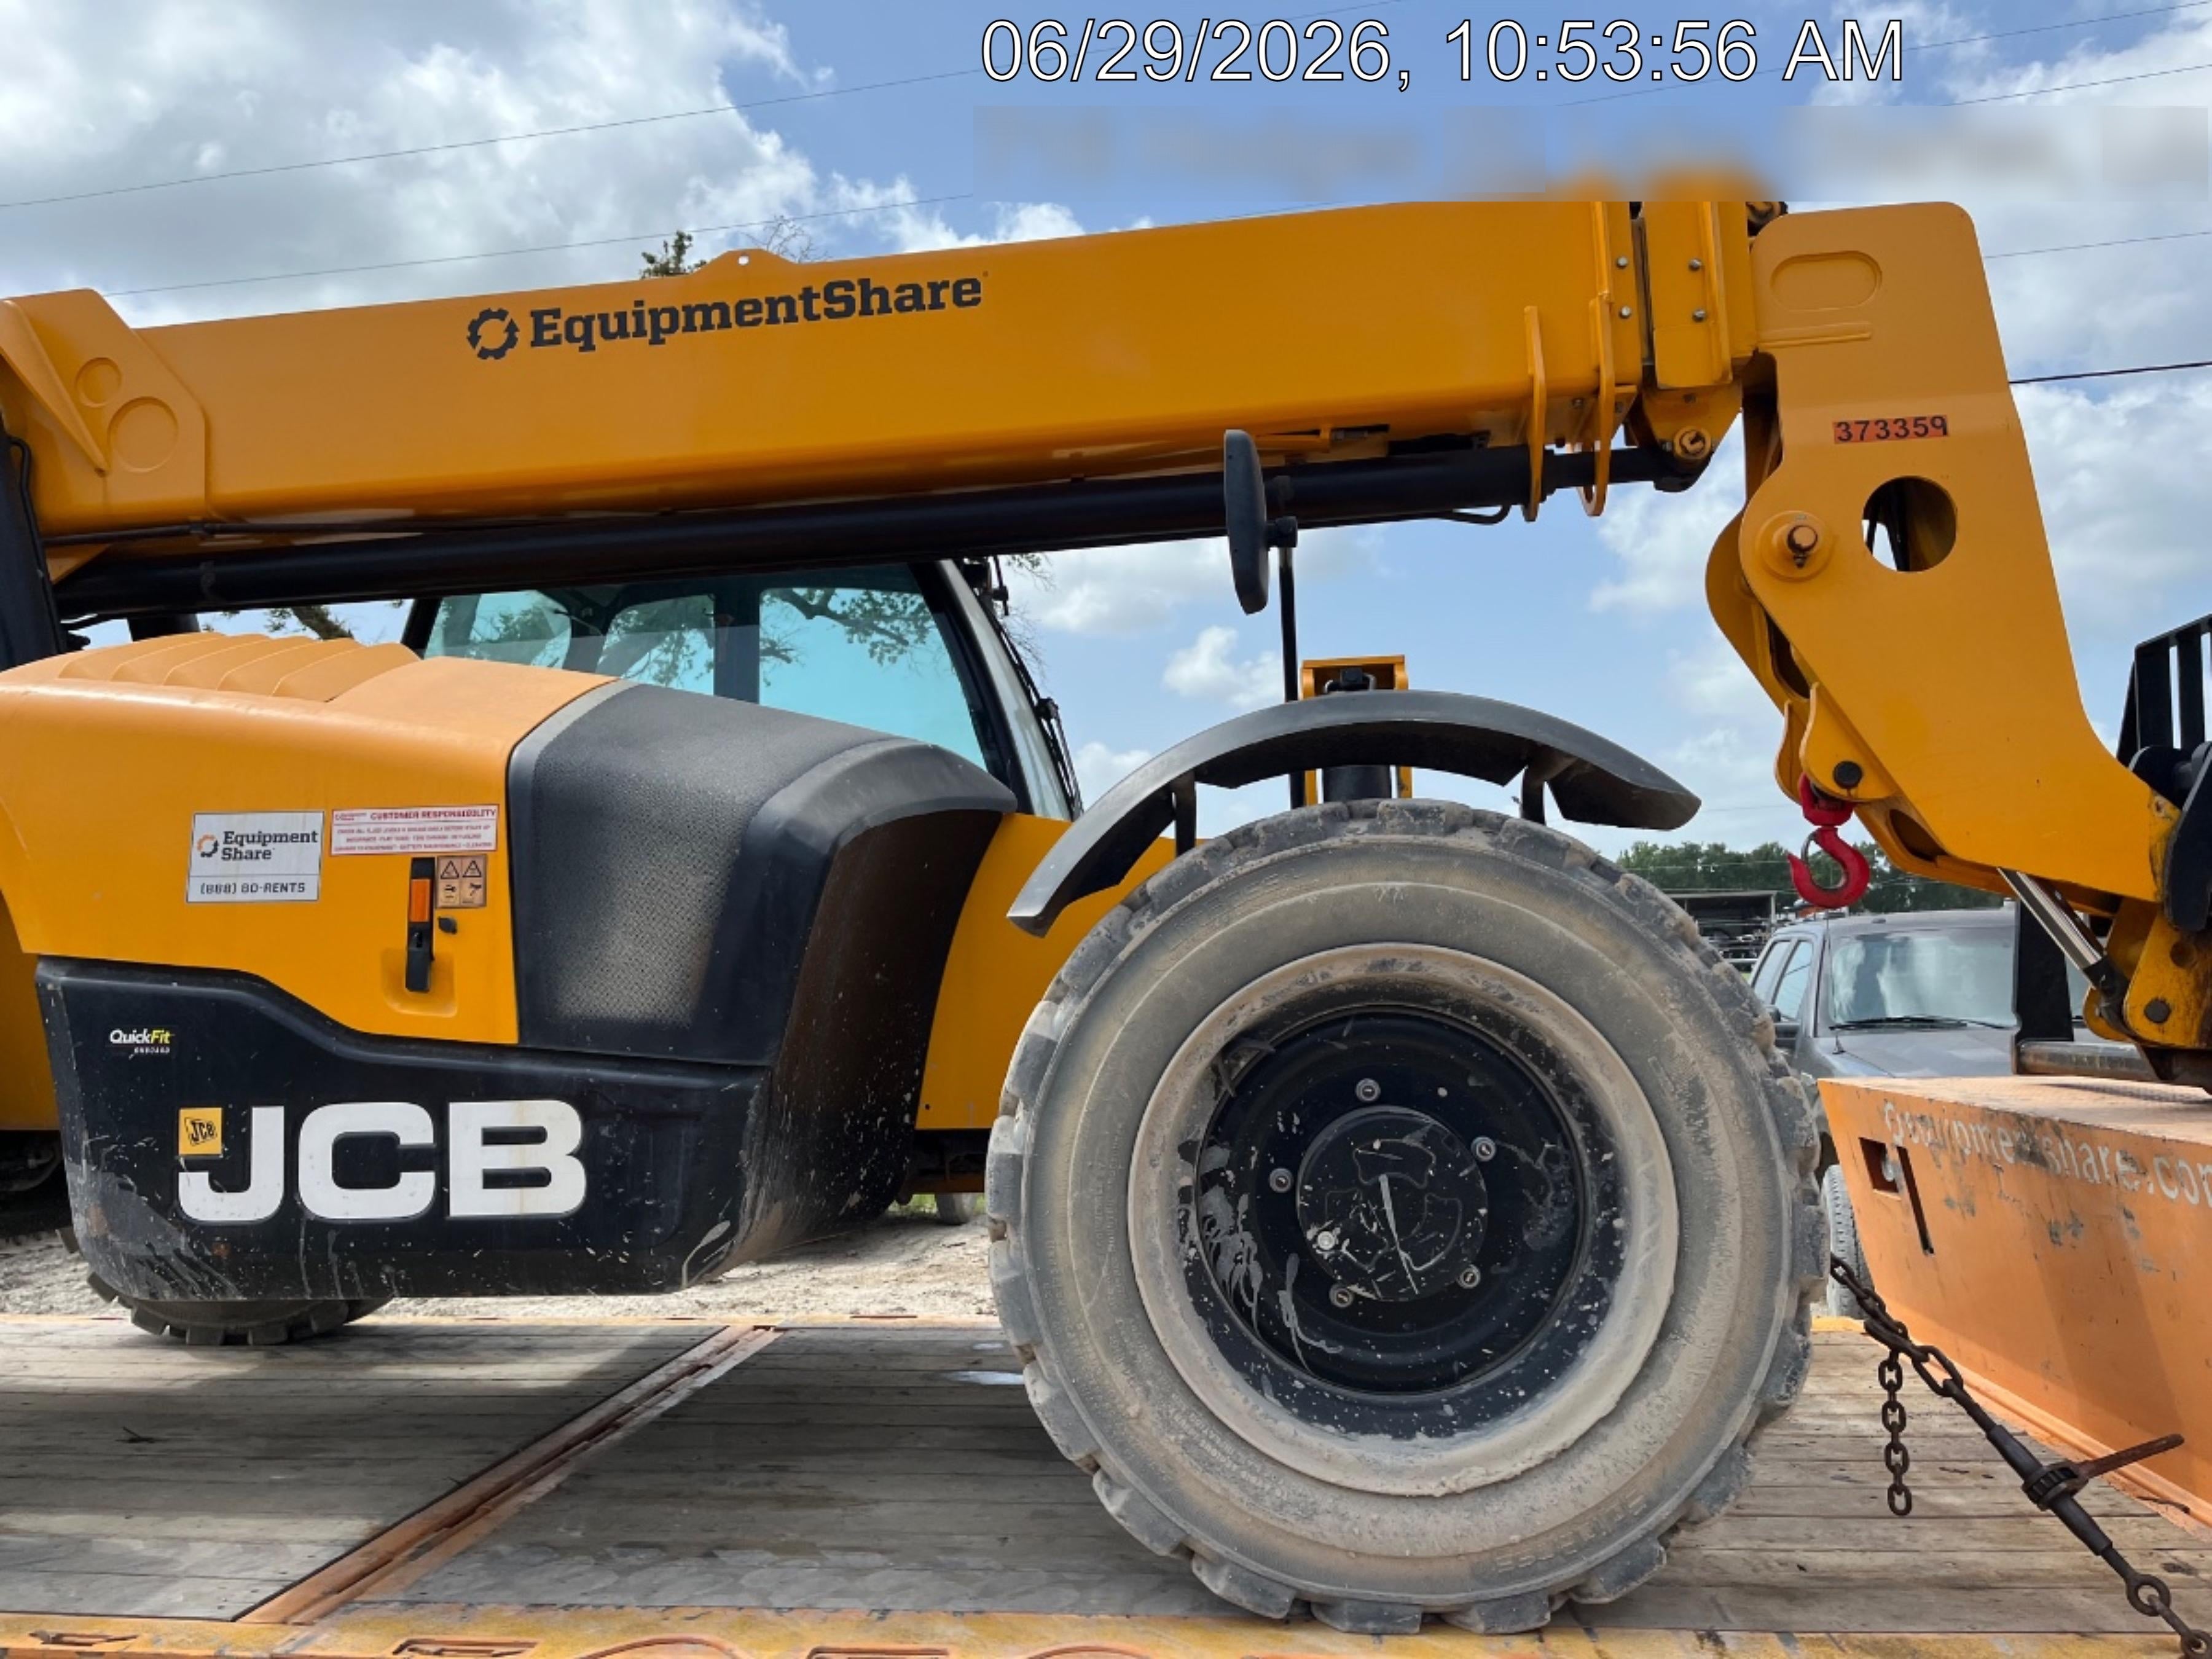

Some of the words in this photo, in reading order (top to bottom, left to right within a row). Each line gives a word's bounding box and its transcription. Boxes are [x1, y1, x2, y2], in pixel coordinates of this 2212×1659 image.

[530, 275, 982, 352] EquipmentShare
[1836, 415, 1948, 443] 373359
[223, 831, 318, 846] Equipment
[221, 847, 272, 861] Share
[109, 1027, 173, 1045] QuickFit
[190, 1119, 216, 1142] JCB
[178, 1099, 587, 1222] JCB
